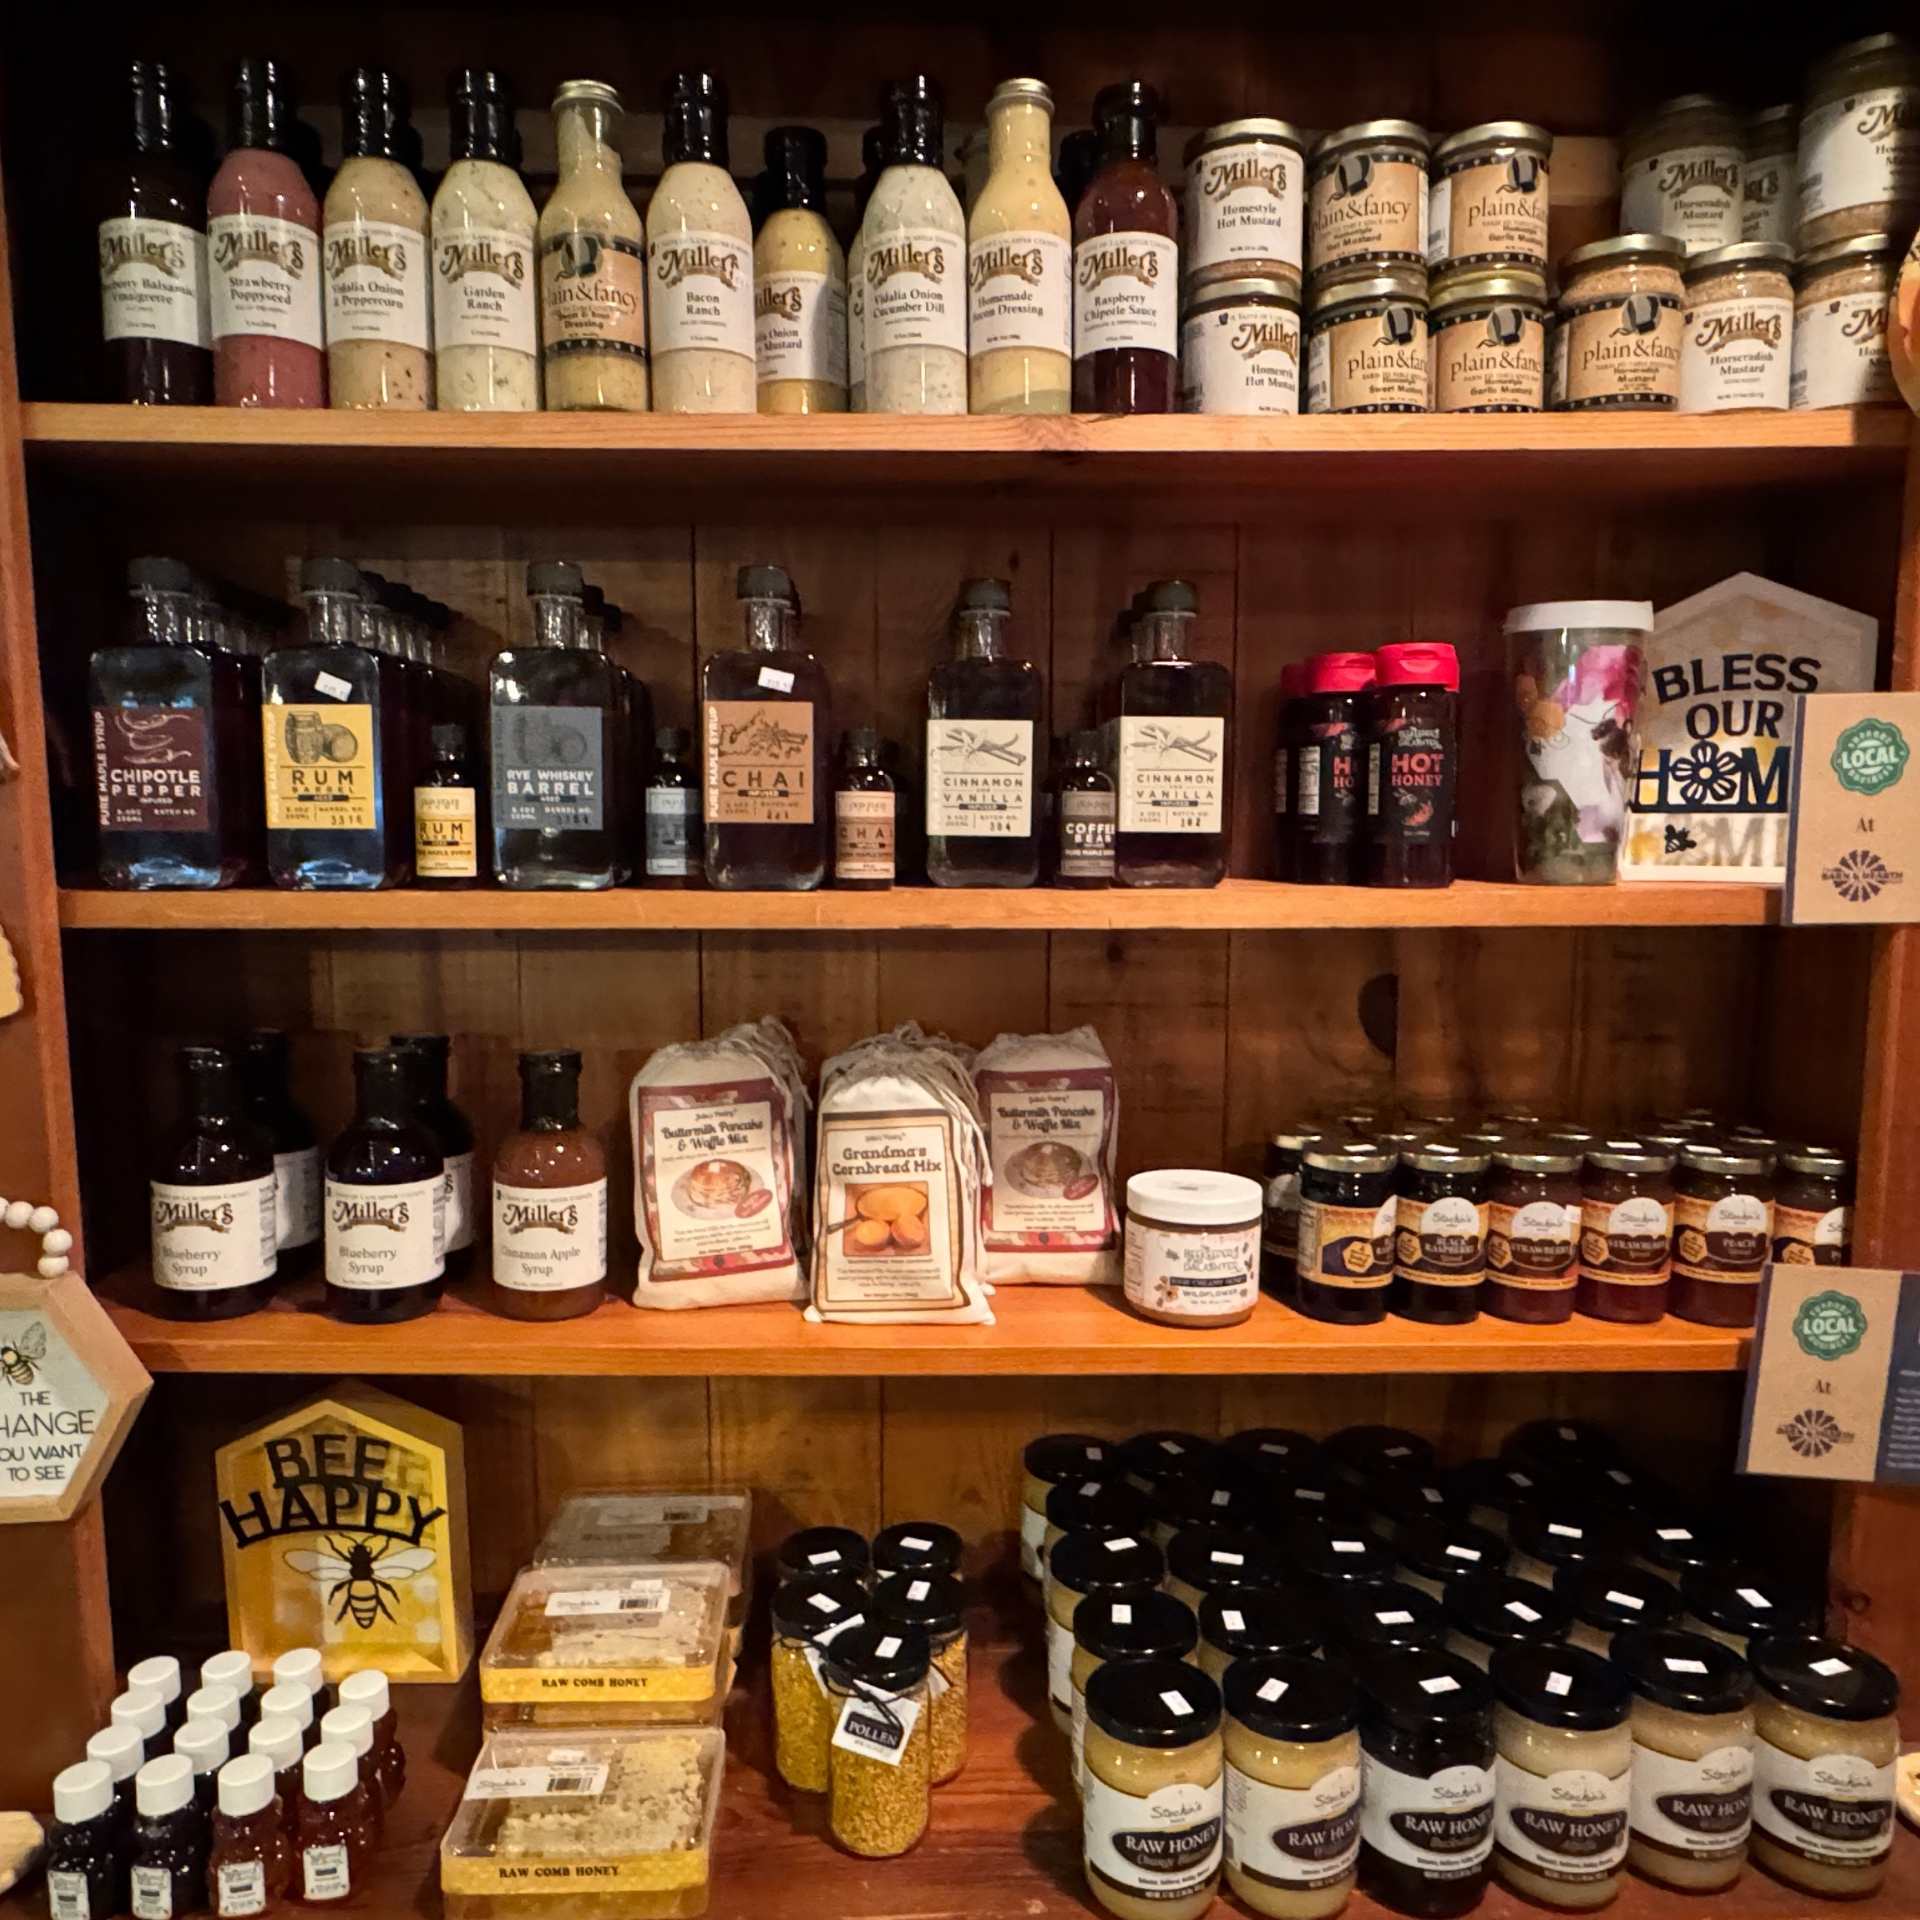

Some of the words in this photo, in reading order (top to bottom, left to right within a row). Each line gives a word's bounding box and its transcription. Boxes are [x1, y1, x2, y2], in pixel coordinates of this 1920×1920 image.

[1222, 203, 1278, 218] Homestyle
[1216, 217, 1237, 229] Hot
[1240, 215, 1282, 229] Mustard
[229, 276, 293, 293] Strawberry
[367, 280, 405, 296] Onion
[230, 290, 292, 305] Poppyseed
[463, 286, 505, 299] Garden
[686, 291, 720, 304] Bacon
[909, 287, 944, 301] Onion
[466, 299, 503, 312] Ranch
[924, 300, 946, 315] Dill
[1094, 293, 1146, 308] Raspberry
[686, 304, 721, 317] Ranch
[997, 302, 1044, 317] Dressing
[1083, 307, 1127, 323] Chipotle
[1128, 305, 1158, 318] Sauce
[1719, 363, 1766, 377] Mustard
[1245, 376, 1265, 387] Hot
[1652, 653, 1823, 705] BLESS
[1685, 699, 1785, 740] OUR
[94, 711, 106, 751] SYRUP
[1391, 752, 1445, 774] HOT
[1841, 745, 1900, 769] LOCAL
[111, 769, 201, 784] CHIPOTLE
[291, 769, 354, 785] RUM
[506, 769, 531, 781] RYE
[537, 769, 594, 782] WHISKEY
[721, 770, 805, 788] CHAI
[943, 777, 1023, 787] CINNAMON
[1136, 774, 1214, 785] CINNAMON
[1391, 774, 1443, 787] HONEY
[111, 784, 201, 797] PEPPER
[506, 781, 595, 796] BARREL
[1136, 790, 1214, 799] VANILLA
[943, 793, 1023, 803] VANILLA
[419, 822, 464, 835] RUM
[1855, 817, 1875, 833] At
[1059, 1119, 1082, 1130] Mix
[727, 1134, 749, 1144] Mix
[842, 1145, 927, 1161] Grandma's
[831, 1160, 912, 1176] Cornbread
[913, 1159, 943, 1173] Mix
[161, 1247, 221, 1262] Blueberry
[338, 1246, 398, 1261] Blueberry
[549, 1246, 582, 1262] Apple
[171, 1262, 208, 1277] Syrup
[347, 1261, 385, 1276] Syrup
[521, 1262, 554, 1277] Syrup
[1802, 1316, 1858, 1336] LOCAL
[1814, 1379, 1833, 1395] At
[19, 1390, 52, 1406] THE
[28, 1443, 83, 1460] WANT
[263, 1433, 391, 1489] BEE
[6, 1466, 31, 1482] TO
[35, 1465, 66, 1481] SEE
[218, 1480, 447, 1549] HAPPY
[541, 1678, 569, 1688] RAW
[573, 1678, 605, 1688] COMB
[608, 1677, 649, 1688] HONEY
[848, 1720, 900, 1748] POLLEN
[1672, 1799, 1715, 1818] RAW
[1784, 1795, 1827, 1820] RAW
[1404, 1814, 1445, 1834] RAW
[1524, 1811, 1566, 1835] RAW
[1126, 1834, 1165, 1854] RAW
[1169, 1823, 1218, 1854] HONEY
[1287, 1831, 1326, 1847] RAW
[498, 1867, 529, 1878] RAW
[534, 1866, 571, 1878] COMB
[575, 1864, 620, 1877] HONEY
